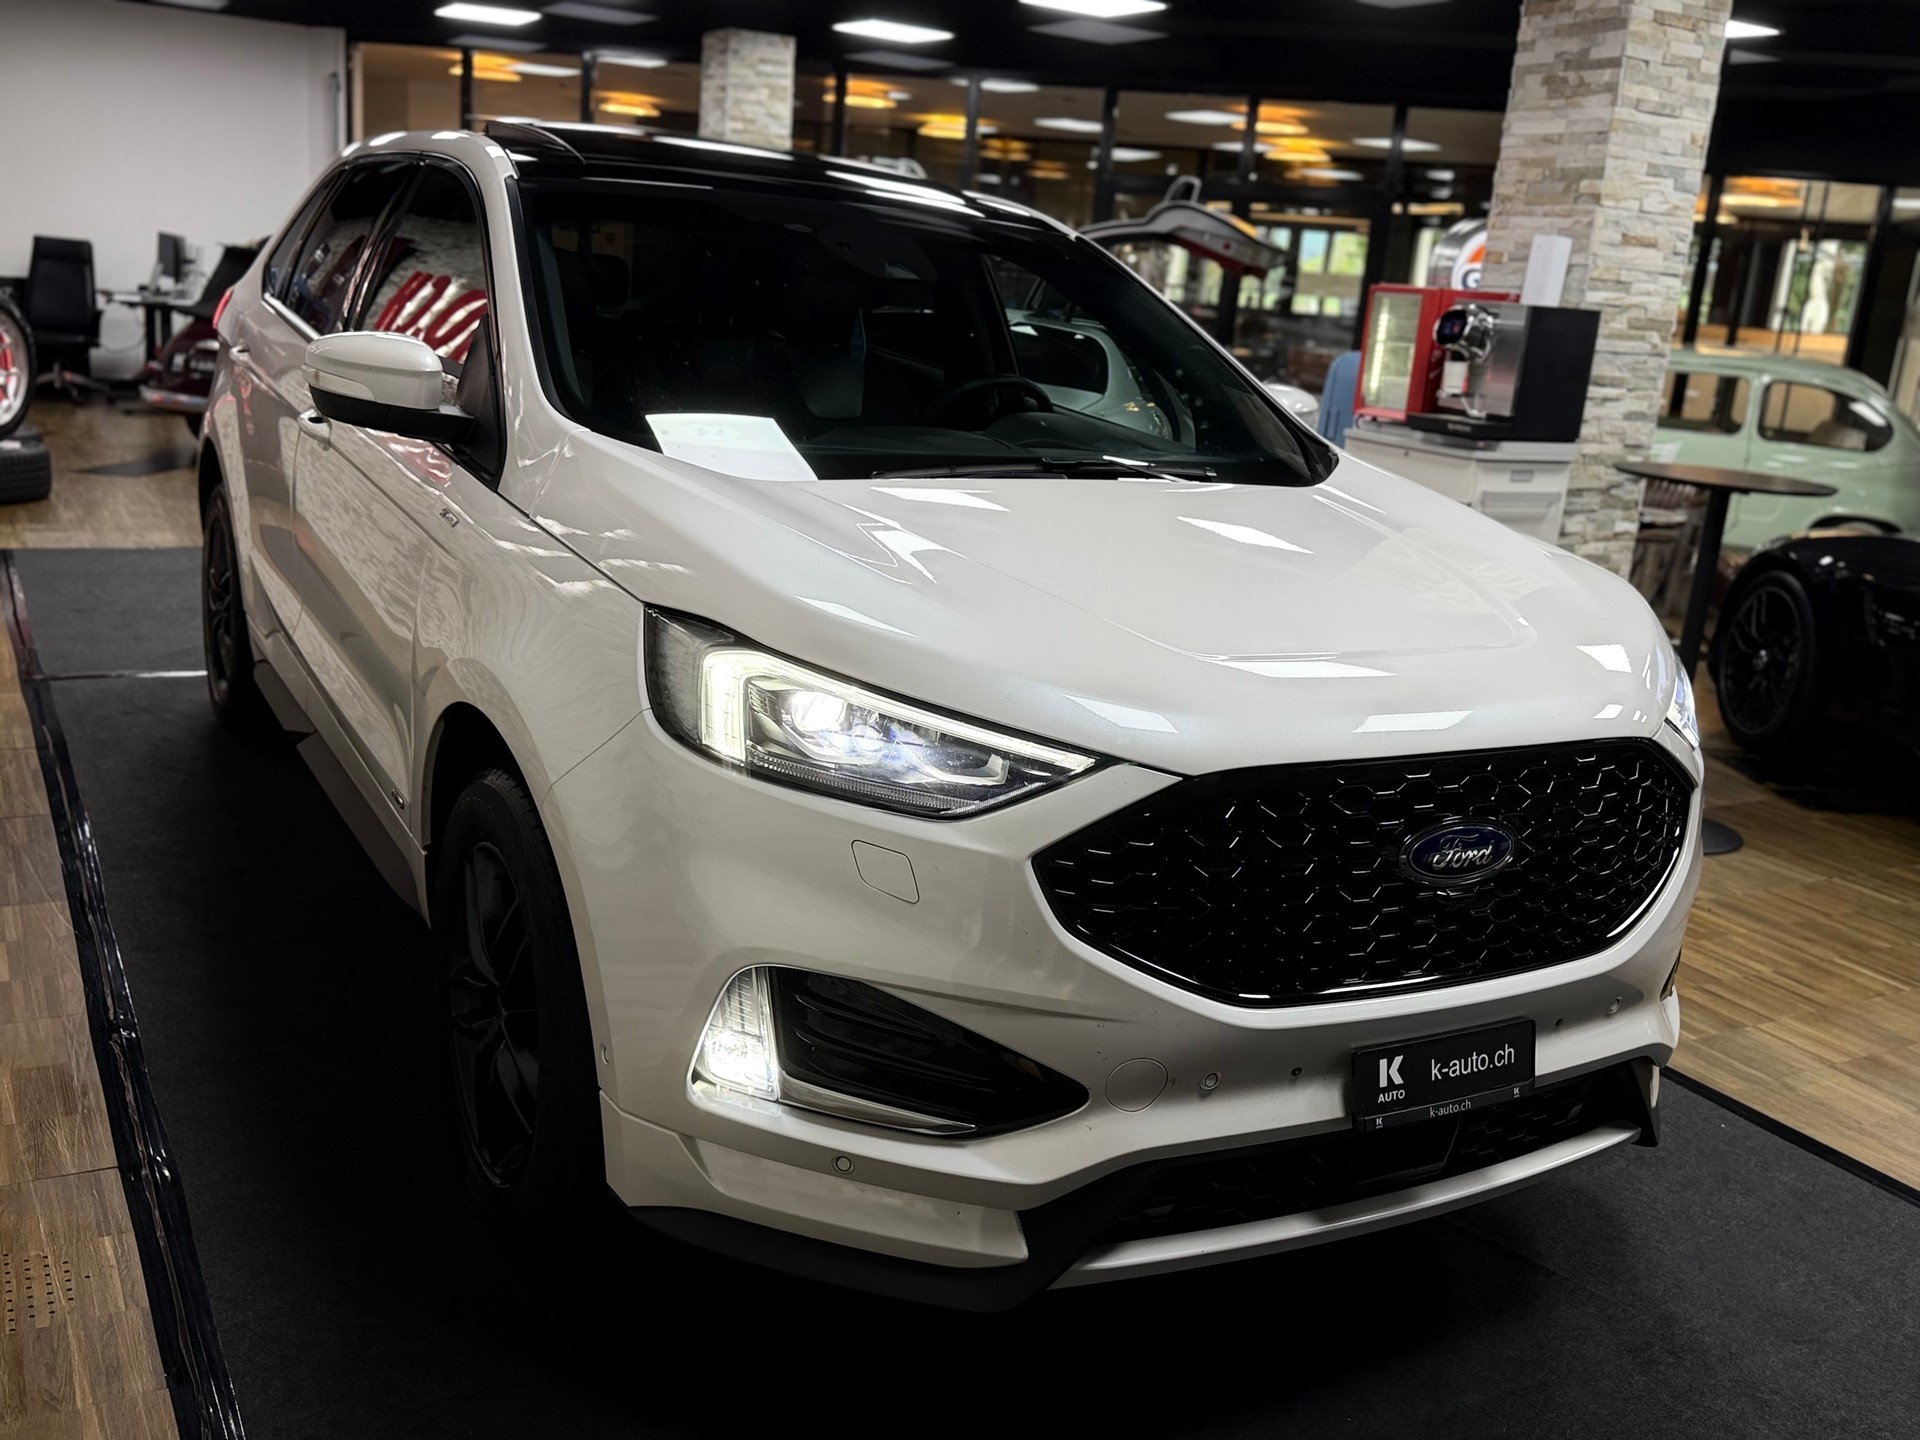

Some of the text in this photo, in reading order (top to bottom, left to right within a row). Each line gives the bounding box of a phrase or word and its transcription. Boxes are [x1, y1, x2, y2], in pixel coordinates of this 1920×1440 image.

[1433, 834, 1495, 869] Ford
[1379, 1055, 1404, 1088] K
[1431, 1043, 1515, 1081] k-auto.ch
[1377, 1089, 1406, 1104] AUTO
[1513, 1086, 1520, 1095] K
[1429, 1099, 1472, 1118] k-auto.ch
[1376, 1117, 1383, 1126] K
